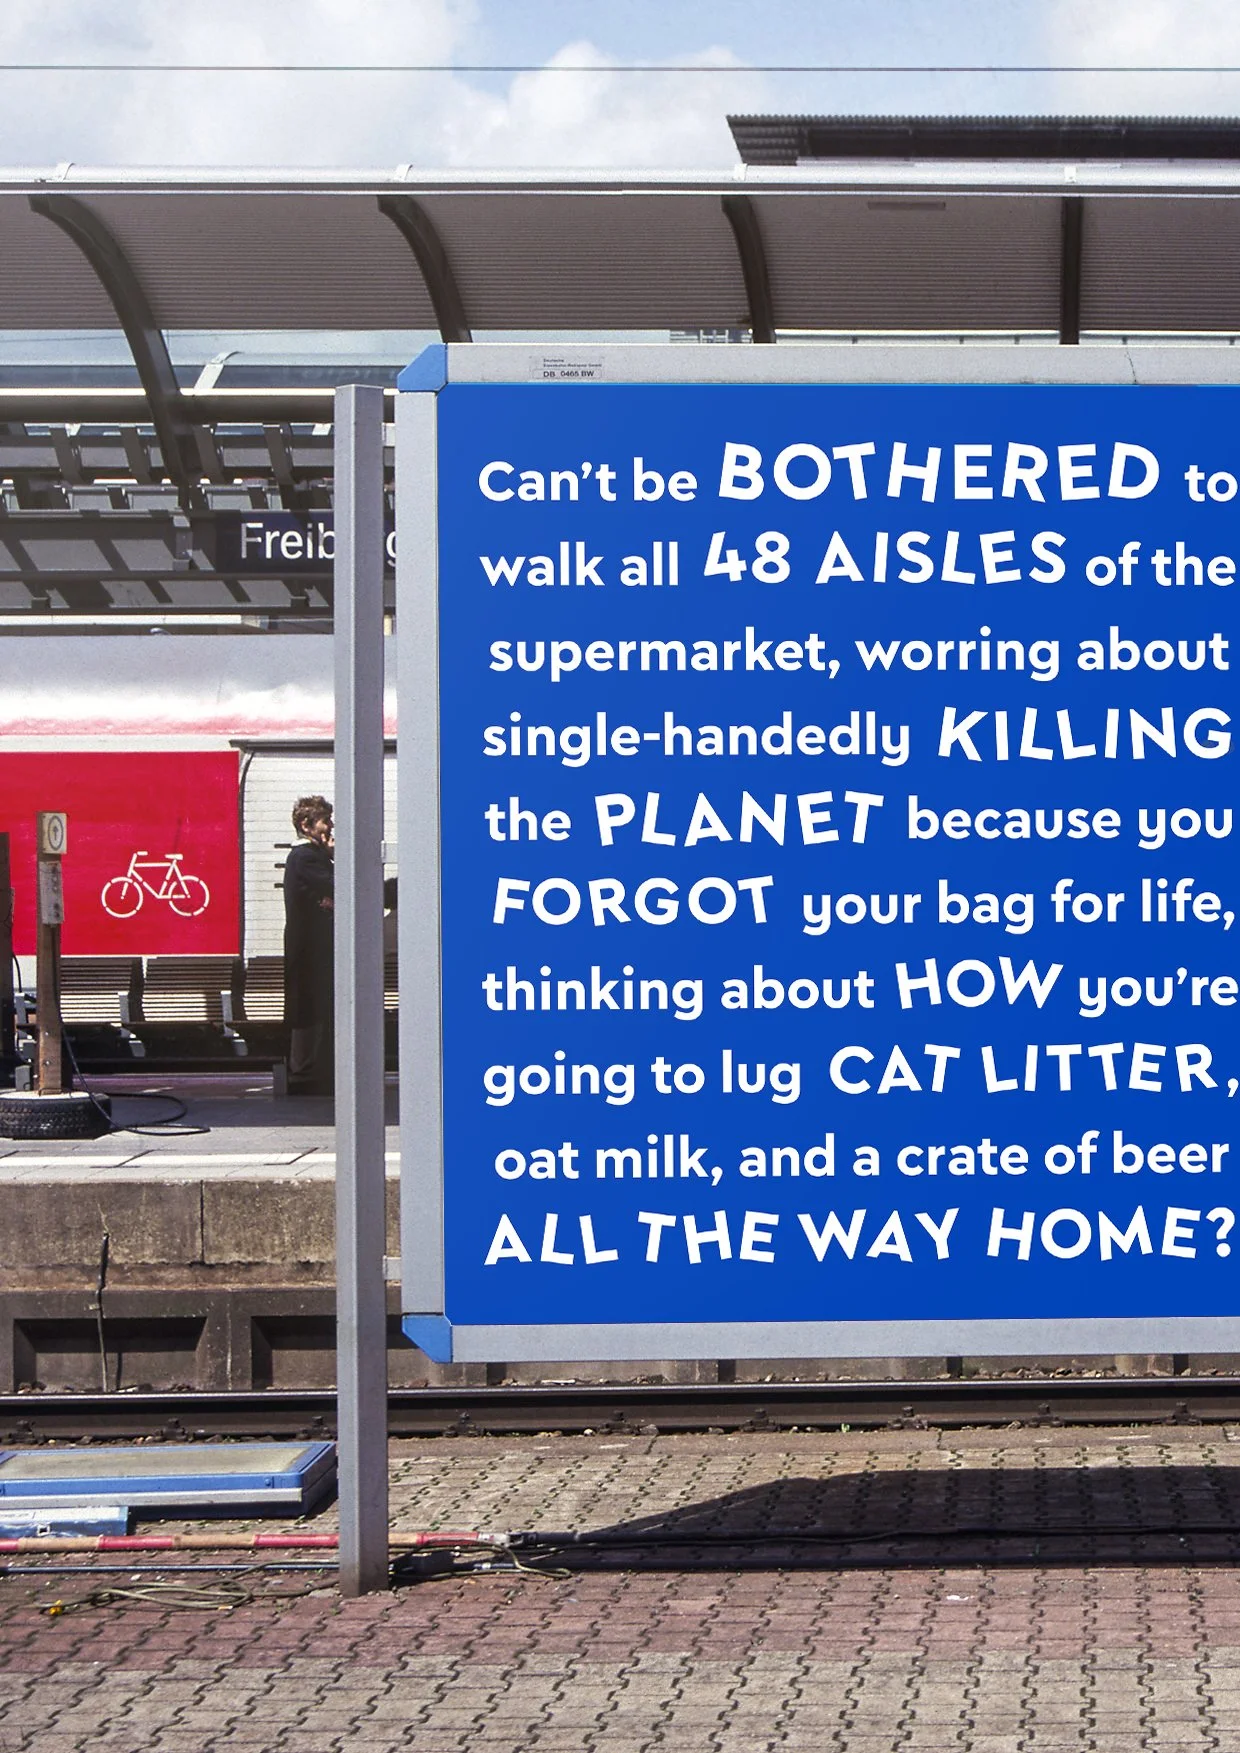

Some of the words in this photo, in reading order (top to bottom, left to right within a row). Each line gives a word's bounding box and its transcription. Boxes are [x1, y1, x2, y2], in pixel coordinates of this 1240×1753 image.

[479, 461, 616, 501] Can’t
[634, 457, 697, 501] be
[719, 442, 1159, 502] BOTHERED
[1185, 465, 1237, 501] to
[241, 522, 396, 567] Freib
[480, 542, 605, 586] walk
[621, 542, 678, 586] all
[704, 531, 790, 583] 48
[816, 531, 1066, 584] AISLES
[1086, 542, 1141, 586] of
[1151, 542, 1235, 586] the
[490, 627, 840, 682] supermarket,
[855, 626, 1059, 681] worring
[1078, 626, 1229, 670] about
[483, 711, 909, 767] single-handedly
[938, 707, 1231, 761] KILLING
[485, 797, 571, 841] the
[595, 791, 884, 846] PLANET
[909, 795, 1120, 839] because
[1138, 808, 1232, 849] you
[493, 876, 773, 926] FORGOT
[803, 894, 921, 935] your
[939, 880, 1033, 934] bag
[1051, 879, 1124, 922] for
[1142, 878, 1234, 930] life,
[482, 965, 702, 1020] thinking
[721, 965, 874, 1009] about
[896, 957, 1063, 1009] HOW
[1079, 968, 1238, 1017] you’re
[484, 1050, 634, 1106] going
[651, 1057, 704, 1093] to
[723, 1050, 800, 1104] lug
[830, 1044, 960, 1094] CAT
[982, 1043, 1238, 1097] LITTER,
[495, 1142, 579, 1179] oat
[597, 1134, 722, 1185] milk,
[740, 1133, 834, 1177] and
[853, 1146, 879, 1176] a
[897, 1139, 1028, 1176] crate
[1045, 1130, 1100, 1174] of
[1114, 1131, 1229, 1174] beer
[485, 1213, 618, 1265] ALL
[638, 1211, 779, 1264] THE
[798, 1208, 959, 1262] WAY
[987, 1206, 1235, 1260] HOME?
